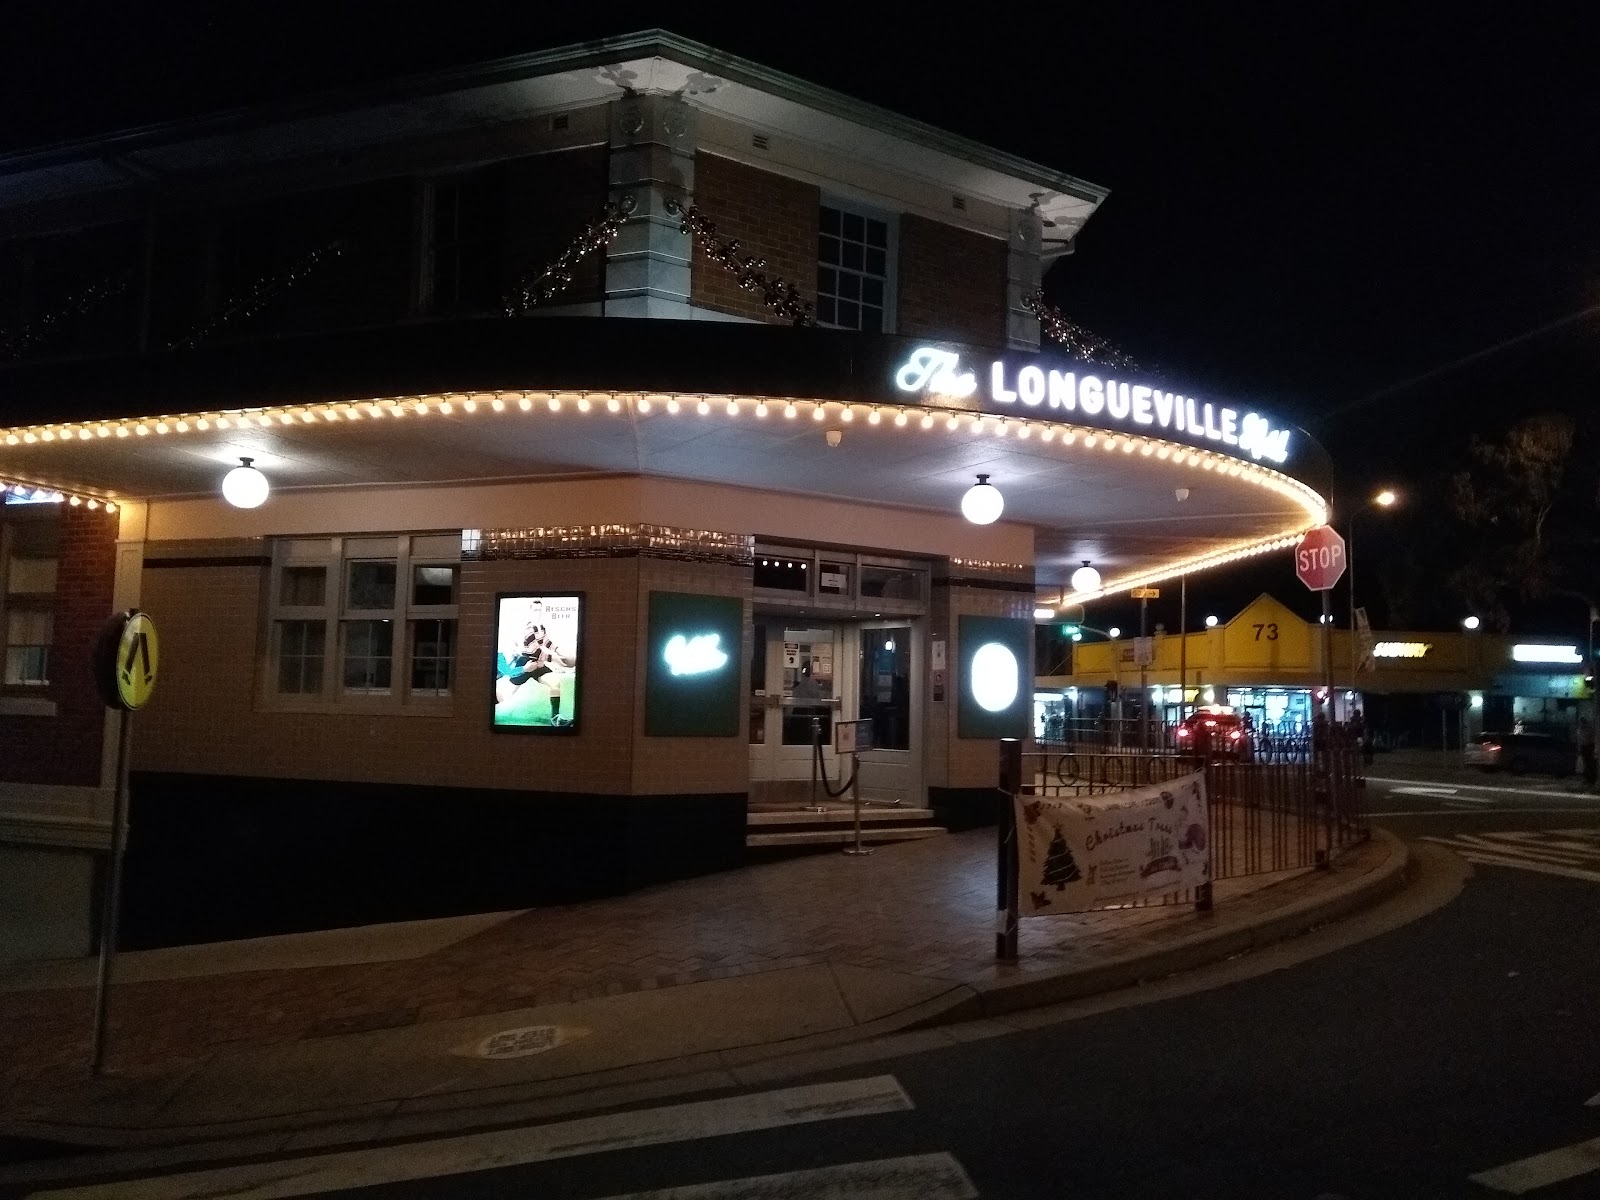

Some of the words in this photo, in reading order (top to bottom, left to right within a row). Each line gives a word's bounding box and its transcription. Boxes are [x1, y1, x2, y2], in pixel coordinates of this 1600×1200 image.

[896, 347, 977, 398] The
[991, 361, 1238, 445] LONGUEVILLE
[1299, 544, 1342, 572] STOP
[1252, 622, 1279, 642] 73
